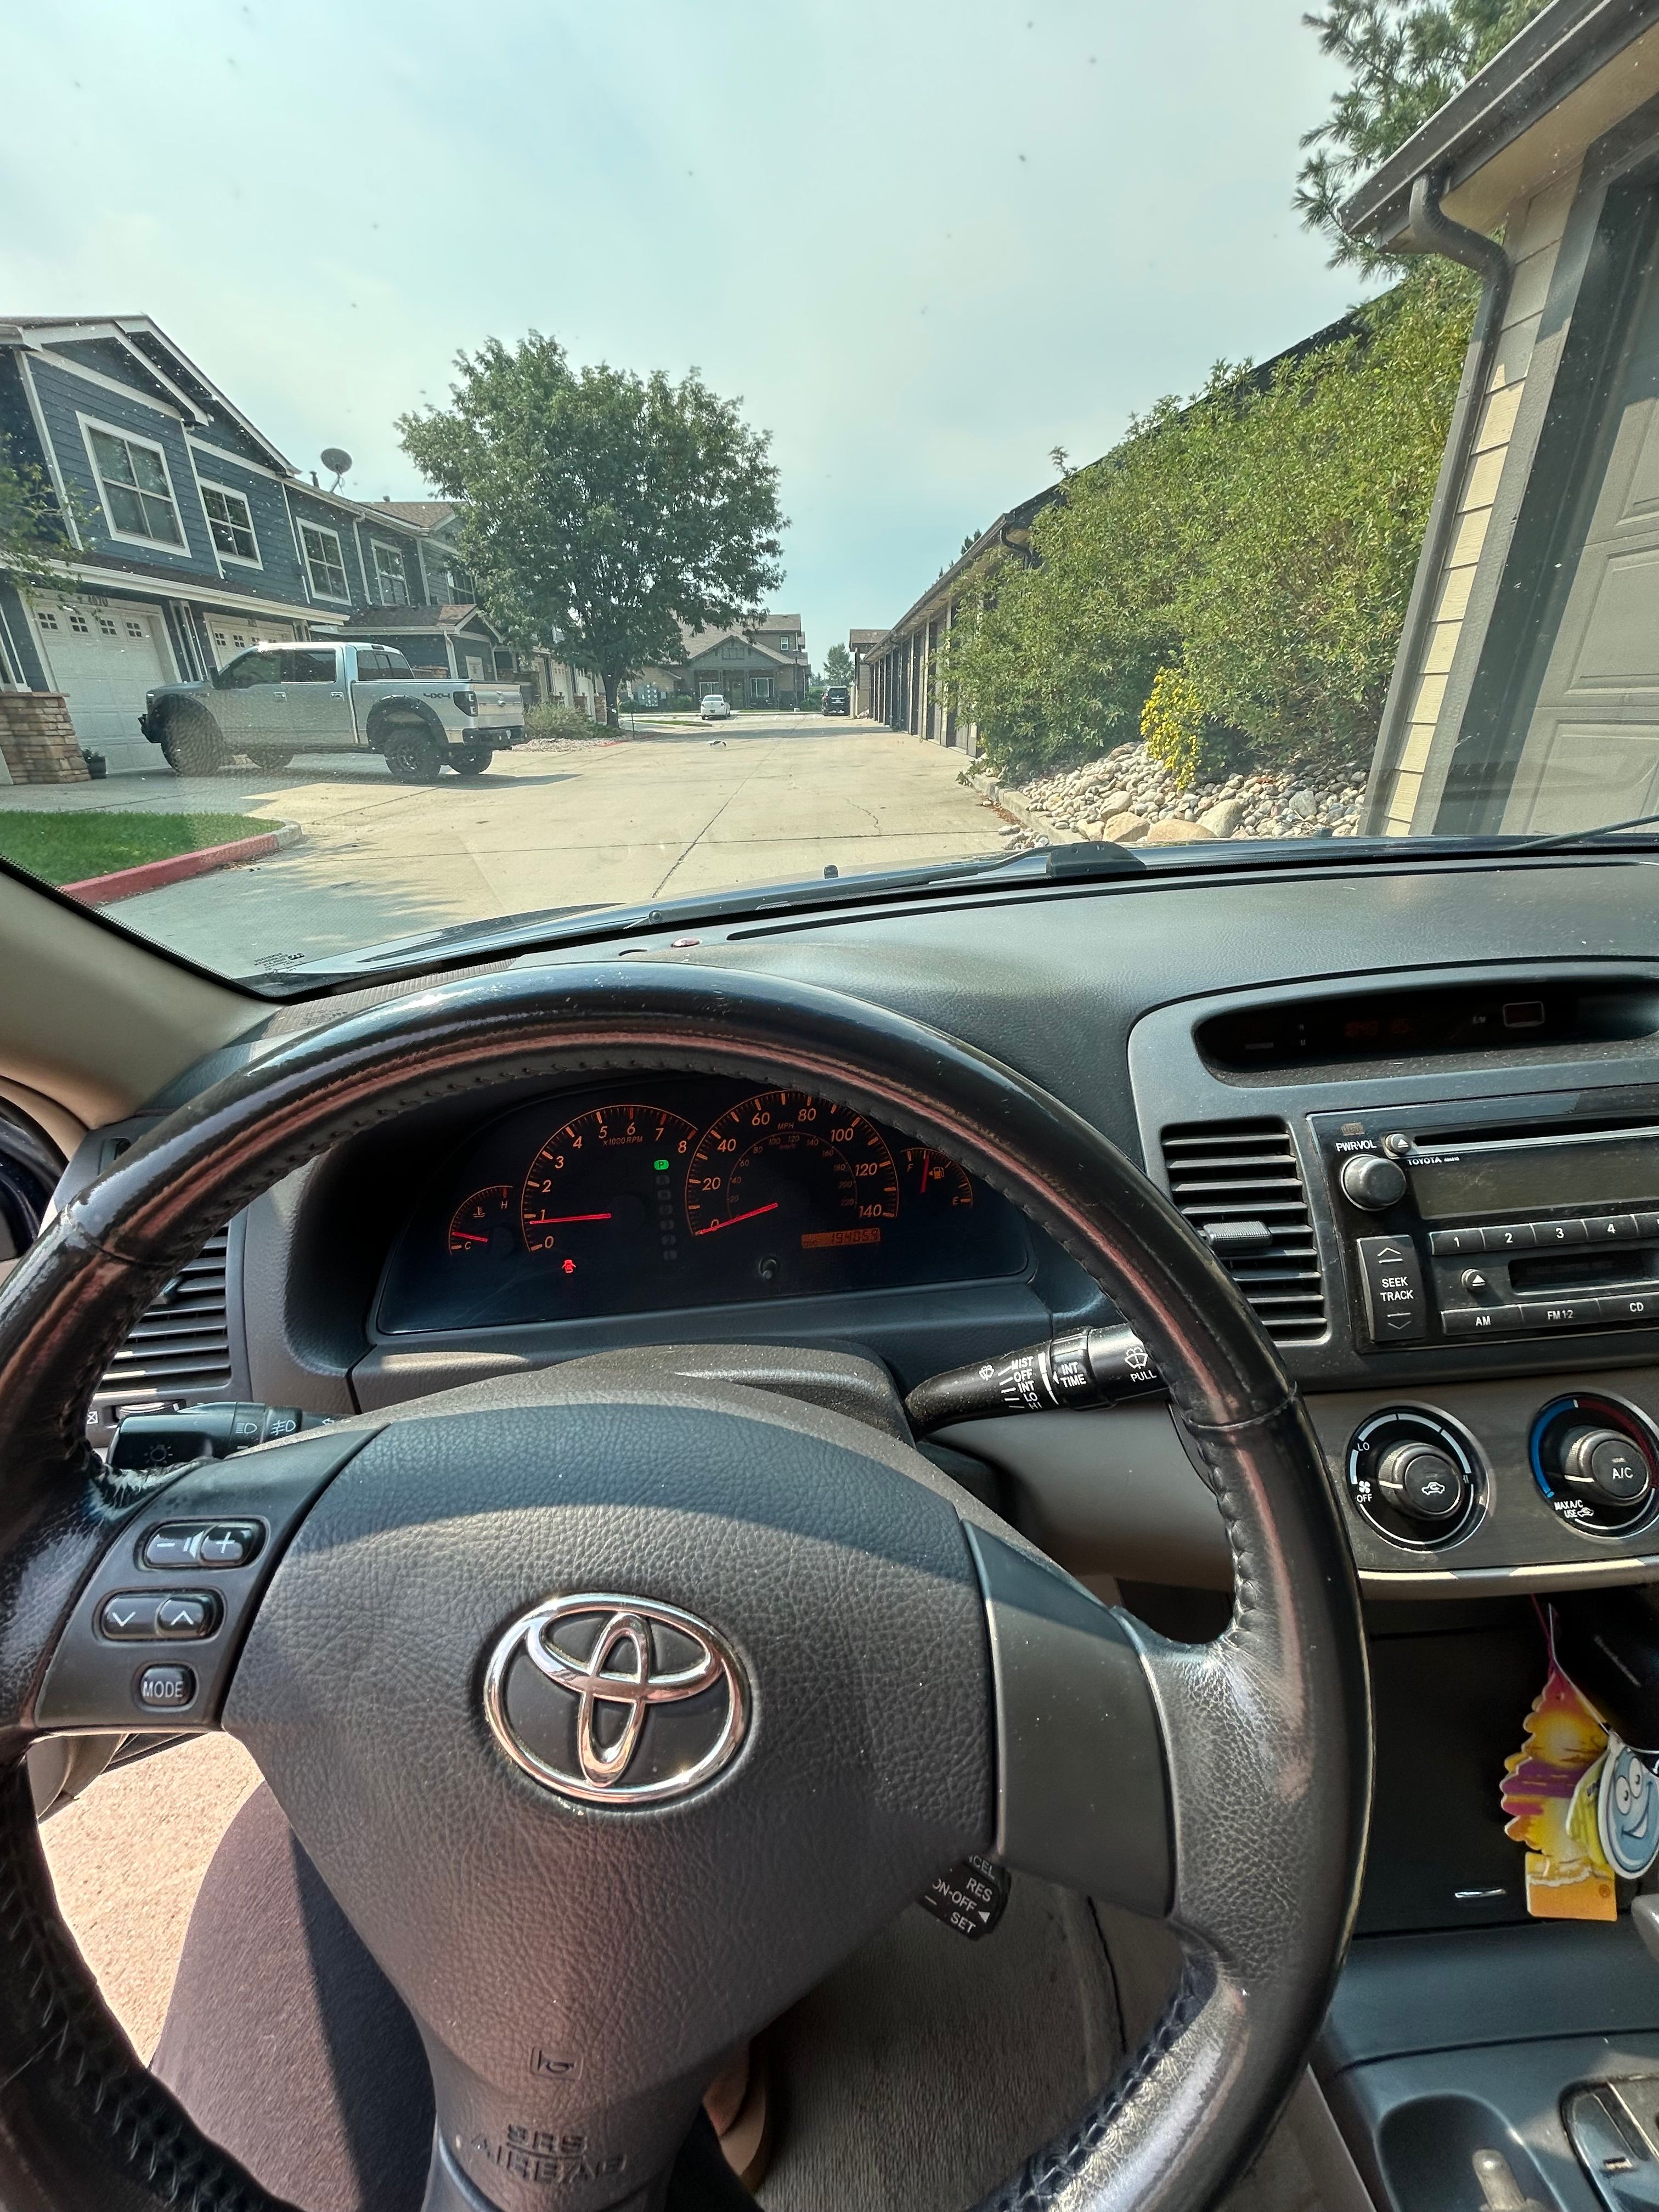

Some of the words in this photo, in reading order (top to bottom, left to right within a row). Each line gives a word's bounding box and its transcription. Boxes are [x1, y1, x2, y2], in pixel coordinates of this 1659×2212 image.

[752, 1113, 770, 1126] 60
[798, 1108, 817, 1121] 80
[599, 1125, 608, 1139] 5
[627, 1121, 636, 1136] 6
[777, 1122, 794, 1130] MPH
[655, 1127, 664, 1141] 7
[830, 1128, 854, 1142] 100
[572, 1136, 583, 1149] 4
[678, 1140, 687, 1153] 8
[718, 1139, 736, 1152] 40
[555, 1155, 565, 1169] 3
[1407, 1156, 1442, 1166] TOYOTA
[855, 1163, 878, 1176] 120
[907, 1164, 913, 1172] F
[542, 1180, 552, 1193] 2
[702, 1177, 721, 1190] 20
[500, 1200, 508, 1210] H
[953, 1197, 959, 1205] E
[540, 1209, 546, 1222] 1
[859, 1205, 882, 1218] 140
[545, 1235, 554, 1249] 0
[1454, 1237, 1460, 1248] 1
[1504, 1233, 1513, 1244] 2
[1556, 1227, 1564, 1239] 3
[1607, 1223, 1616, 1234] 4
[464, 1241, 471, 1251] C
[1382, 1277, 1408, 1288] SEEK
[1380, 1290, 1414, 1302] TRACK
[1629, 1301, 1644, 1313] CD
[1476, 1316, 1491, 1327] AM
[1547, 1310, 1561, 1320] FM
[1011, 1356, 1034, 1370] MIST
[1061, 1362, 1078, 1375] INT
[1013, 1368, 1032, 1383] OFF
[1060, 1374, 1087, 1387] TIME
[1130, 1371, 1157, 1383] PULL
[1018, 1380, 1035, 1393] INT
[1023, 1392, 1038, 1402] LO
[1357, 1442, 1370, 1452] LO
[1612, 1468, 1633, 1480] A/C
[1356, 1494, 1372, 1503] OFF
[1554, 1500, 1570, 1510] MAX
[1570, 1499, 1583, 1509] A/C
[1564, 1509, 1578, 1519] USE
[143, 1680, 184, 1698] MODE
[966, 1877, 992, 1902] RES
[950, 1911, 977, 1933] SET
[506, 2123, 588, 2154] SRS
